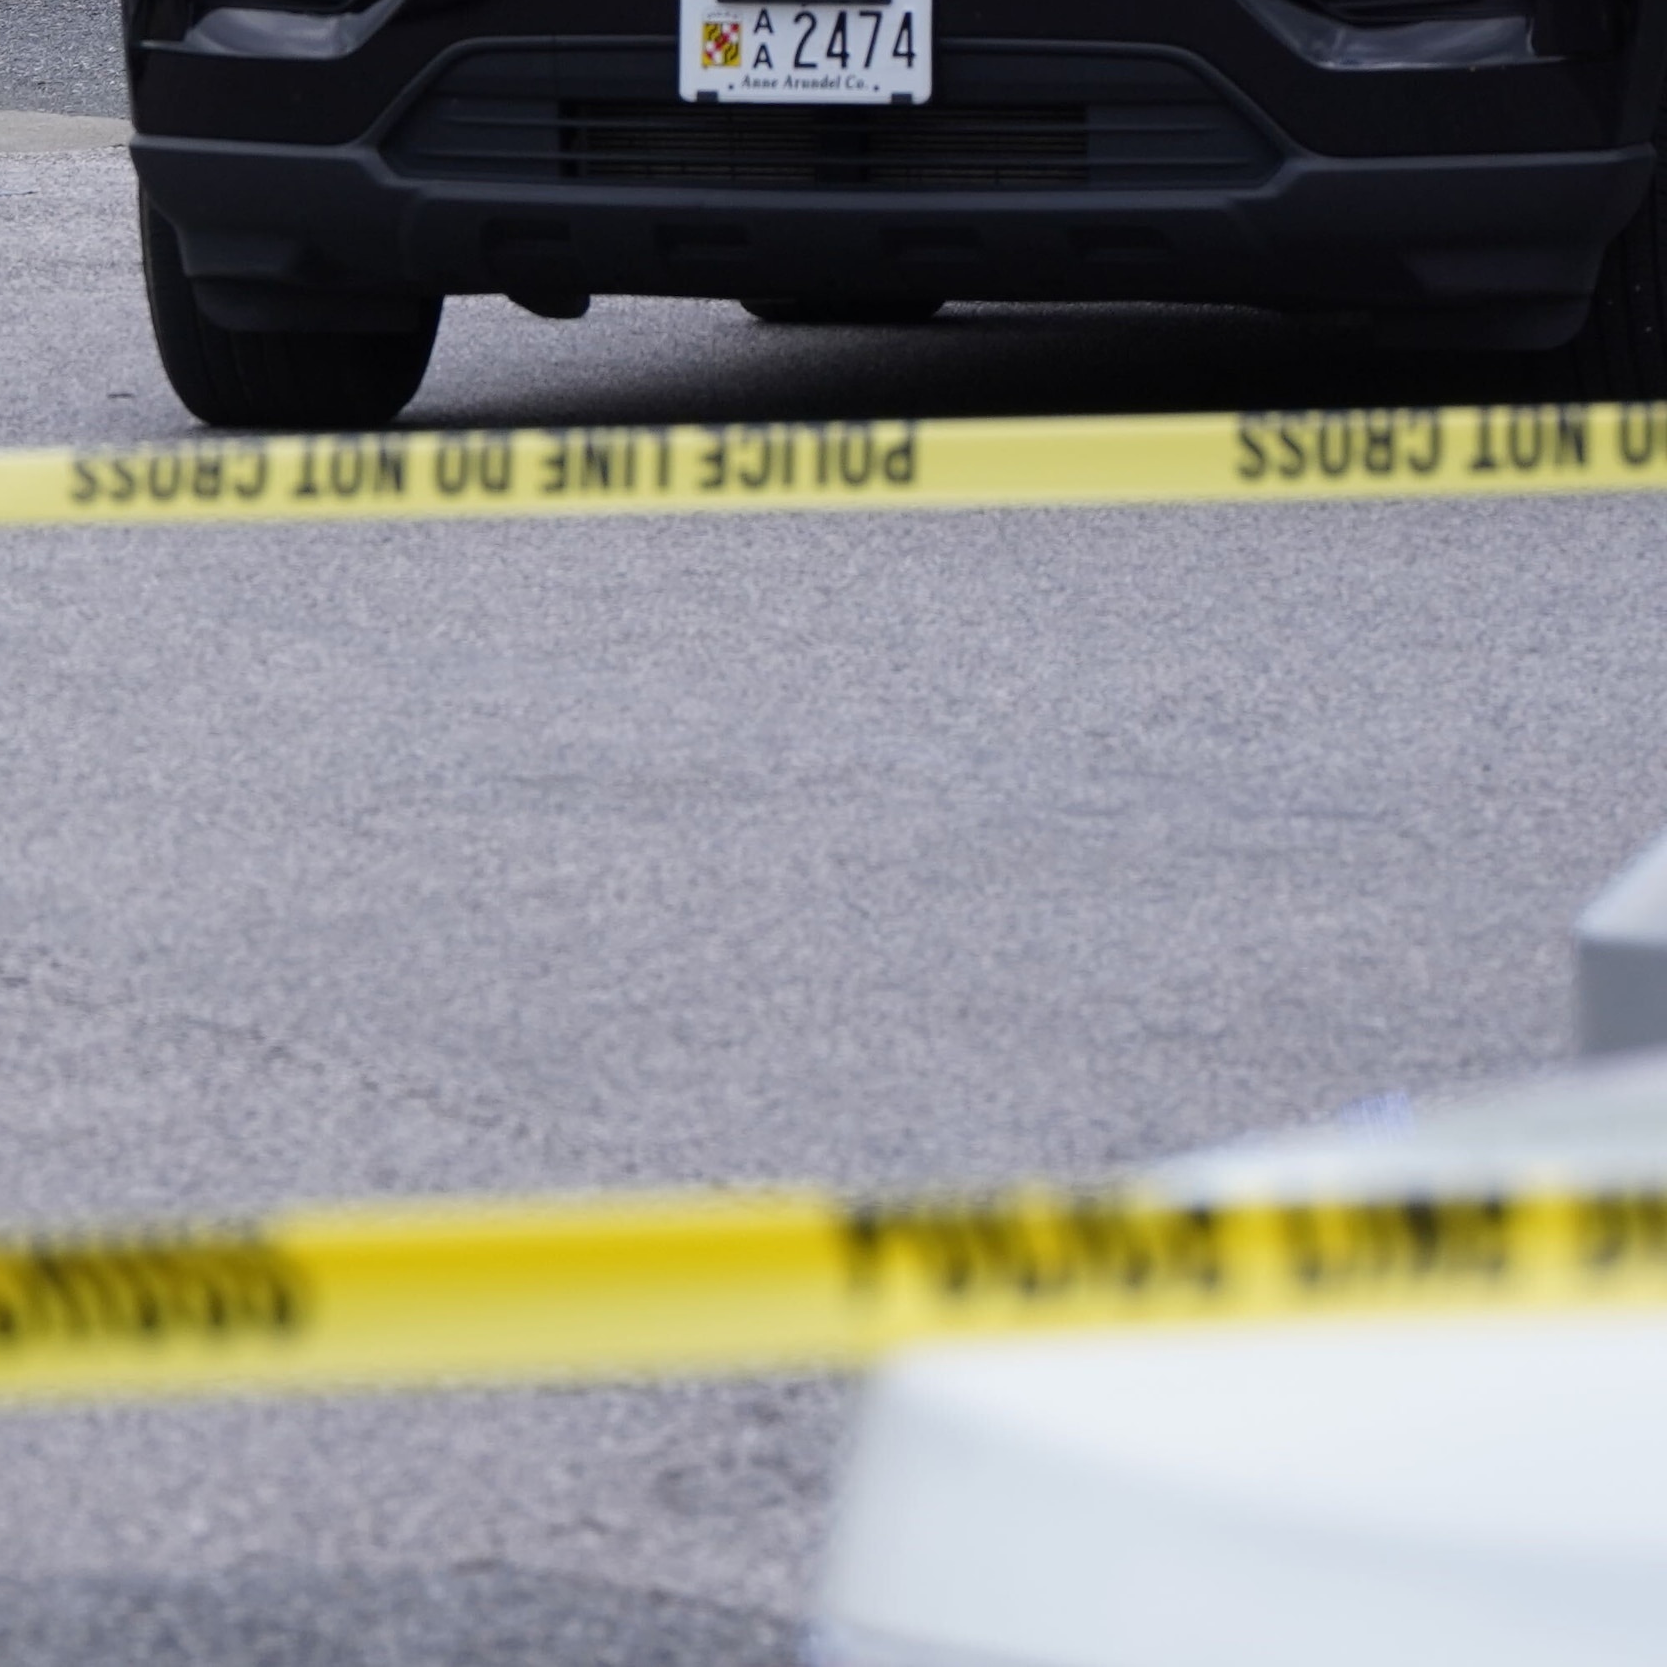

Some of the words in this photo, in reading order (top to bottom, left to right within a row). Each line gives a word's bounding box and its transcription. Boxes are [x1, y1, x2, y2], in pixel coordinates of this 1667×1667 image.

[792, 9, 916, 70] 2474
[741, 73, 779, 90] Anne
[783, 73, 842, 90] Arundel
[289, 437, 405, 499] NOT
[436, 434, 512, 496] DO
[542, 428, 670, 493] LINE
[701, 420, 918, 491] POLICE
[1237, 410, 1442, 479] CROSS
[1471, 406, 1586, 470] NOT
[72, 444, 265, 503] CROSS
